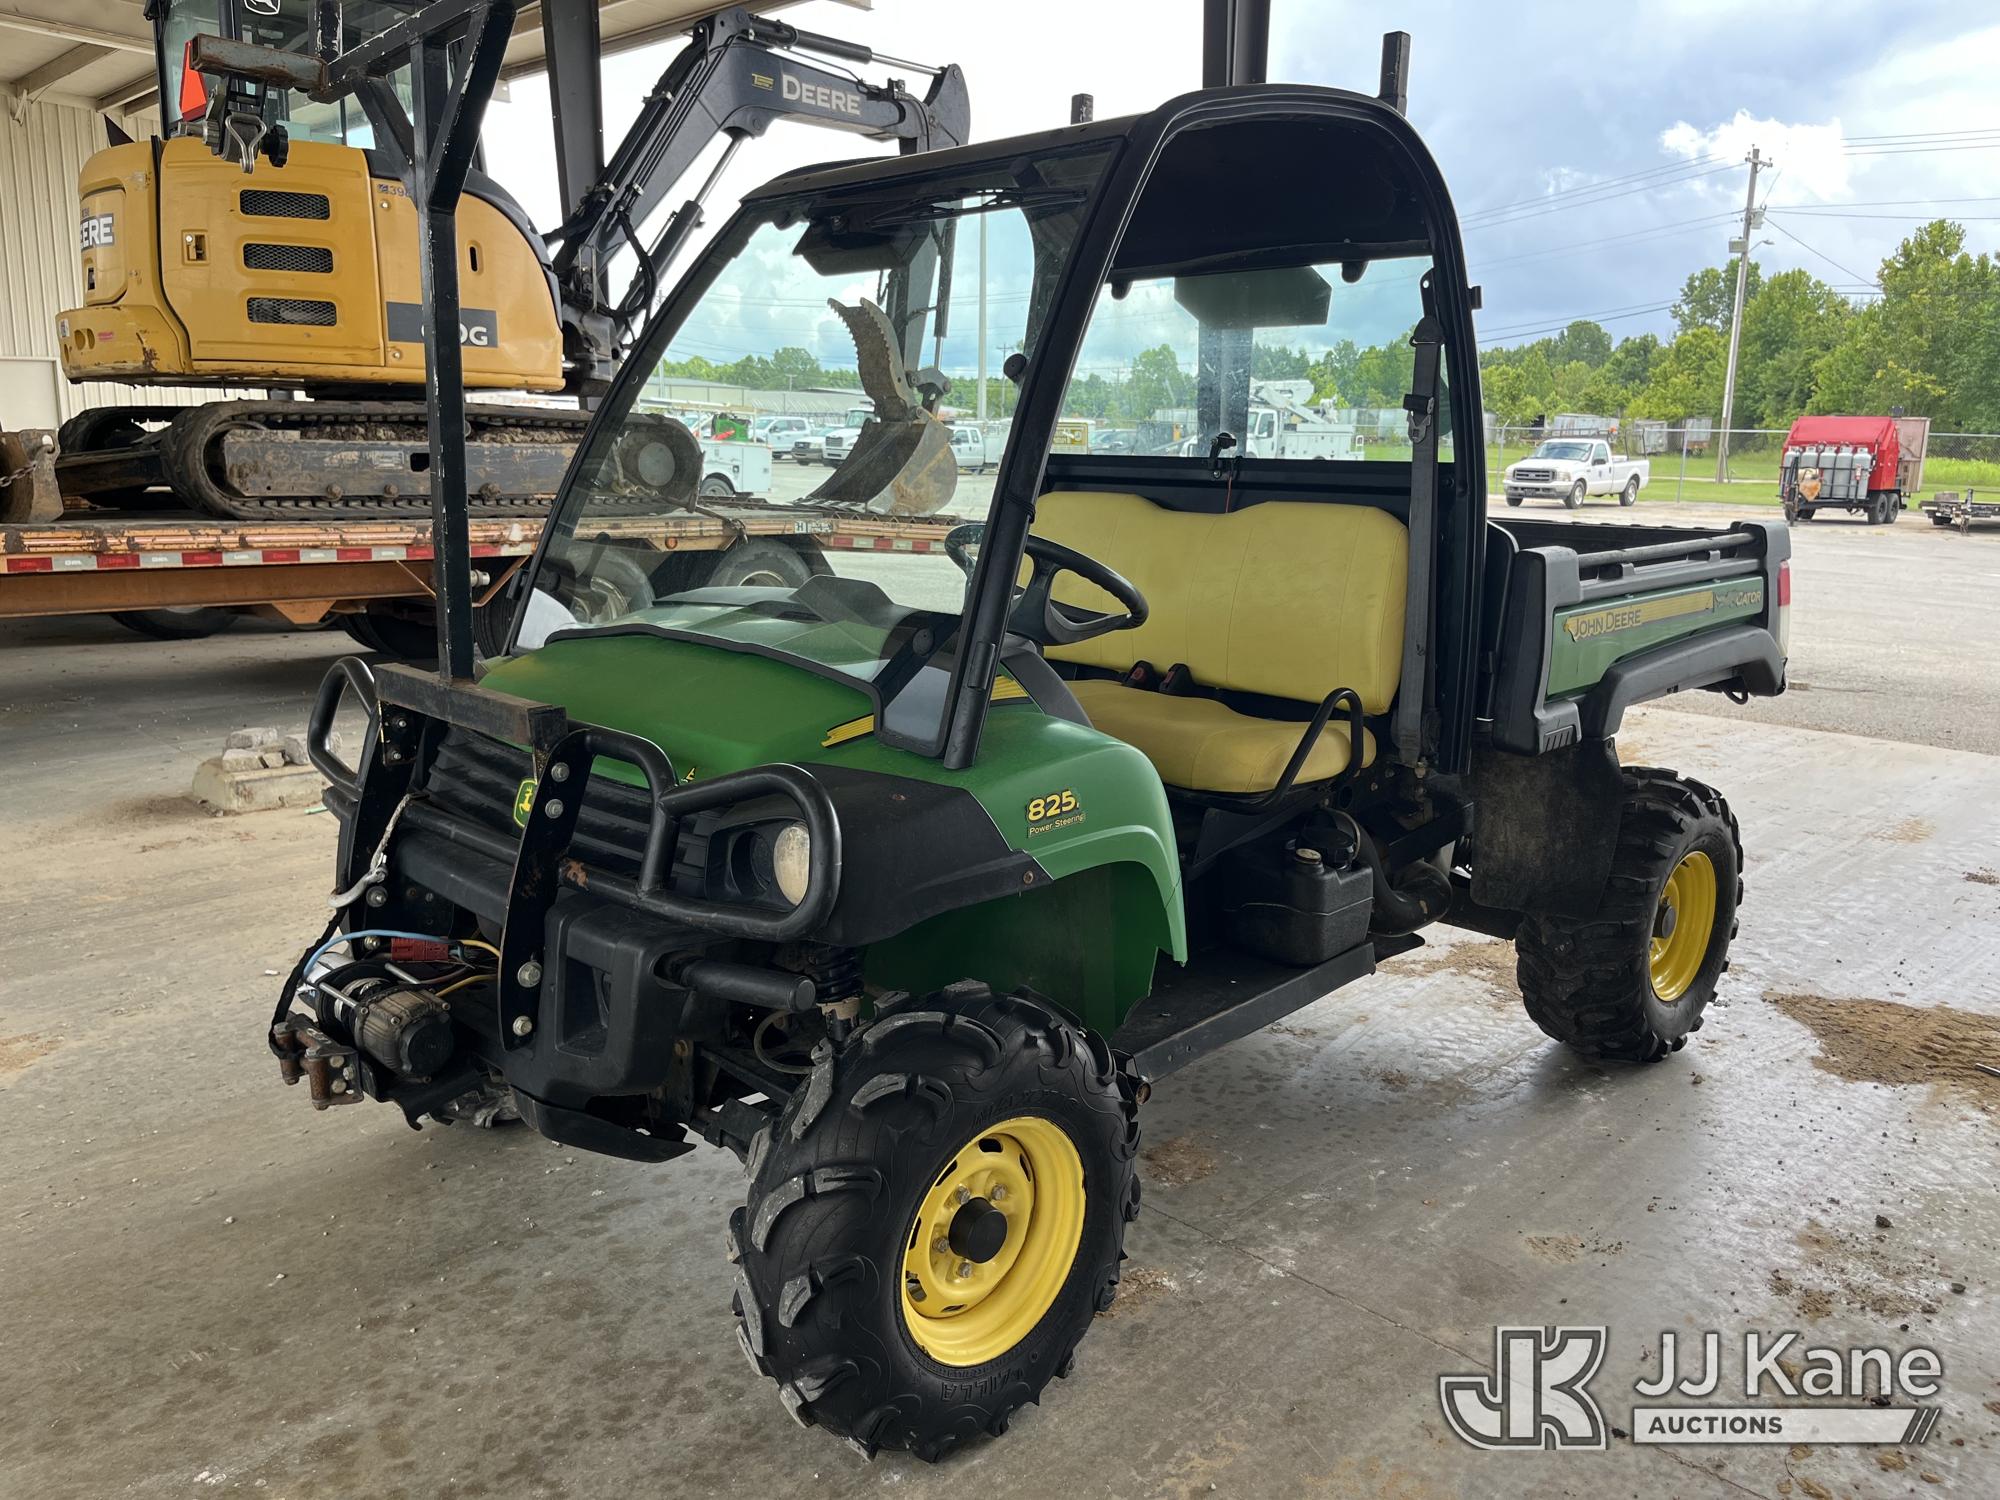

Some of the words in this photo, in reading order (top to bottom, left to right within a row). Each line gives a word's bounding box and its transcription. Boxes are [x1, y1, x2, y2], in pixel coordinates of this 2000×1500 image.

[782, 74, 861, 115] DEERE
[1575, 618, 1604, 638] JOHN
[1606, 610, 1643, 631] DEERE
[1029, 823, 1053, 837] Power
[1054, 813, 1086, 828] Steering
